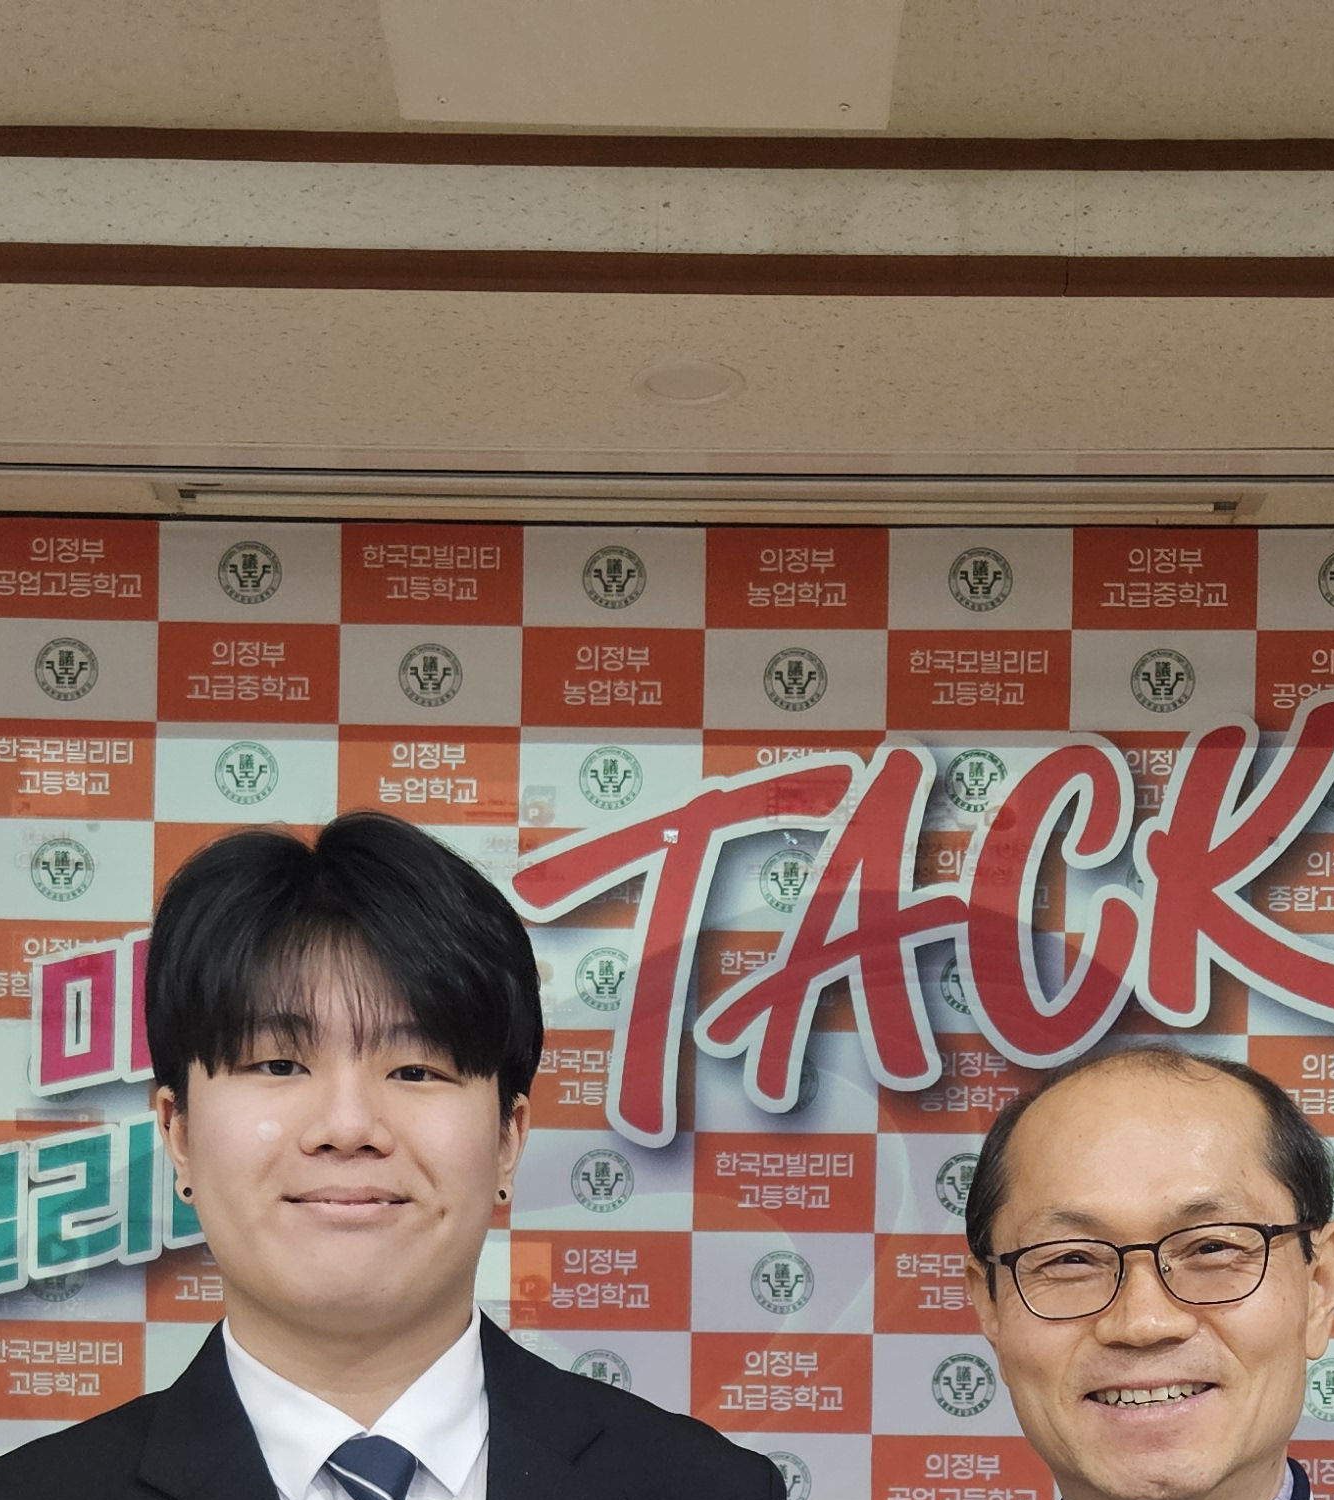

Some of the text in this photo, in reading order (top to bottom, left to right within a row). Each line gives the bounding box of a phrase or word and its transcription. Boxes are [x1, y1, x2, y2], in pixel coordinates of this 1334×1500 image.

[30, 537, 105, 564] 의정부
[362, 544, 501, 570] 한국모빌리티
[759, 547, 836, 574] 의정부
[1127, 547, 1204, 574] 의정부
[385, 575, 479, 601] 고등학교
[746, 581, 848, 608] 농업학교
[1100, 581, 1229, 609] 고급중학교
[210, 640, 286, 668] 의정부
[575, 645, 651, 673] 의정부
[909, 649, 1049, 675] 한국모빌리티
[186, 674, 311, 702] 고급중학교
[562, 679, 663, 706] 농업학교
[931, 681, 1025, 707] 고등학교
[391, 742, 466, 771] 의정부
[17, 768, 110, 796] 고등학교
[378, 776, 478, 804] 농업학교
[715, 1151, 855, 1178] 한국모빌리티
[736, 1184, 831, 1210] 고등학교
[563, 1247, 639, 1276] 의정부
[551, 1282, 651, 1309] 농업학교
[743, 1349, 819, 1378] 의정부
[8, 1370, 101, 1397] 고등학교
[718, 1383, 844, 1413] 고급중학교
[924, 1453, 1001, 1481] 의정부
